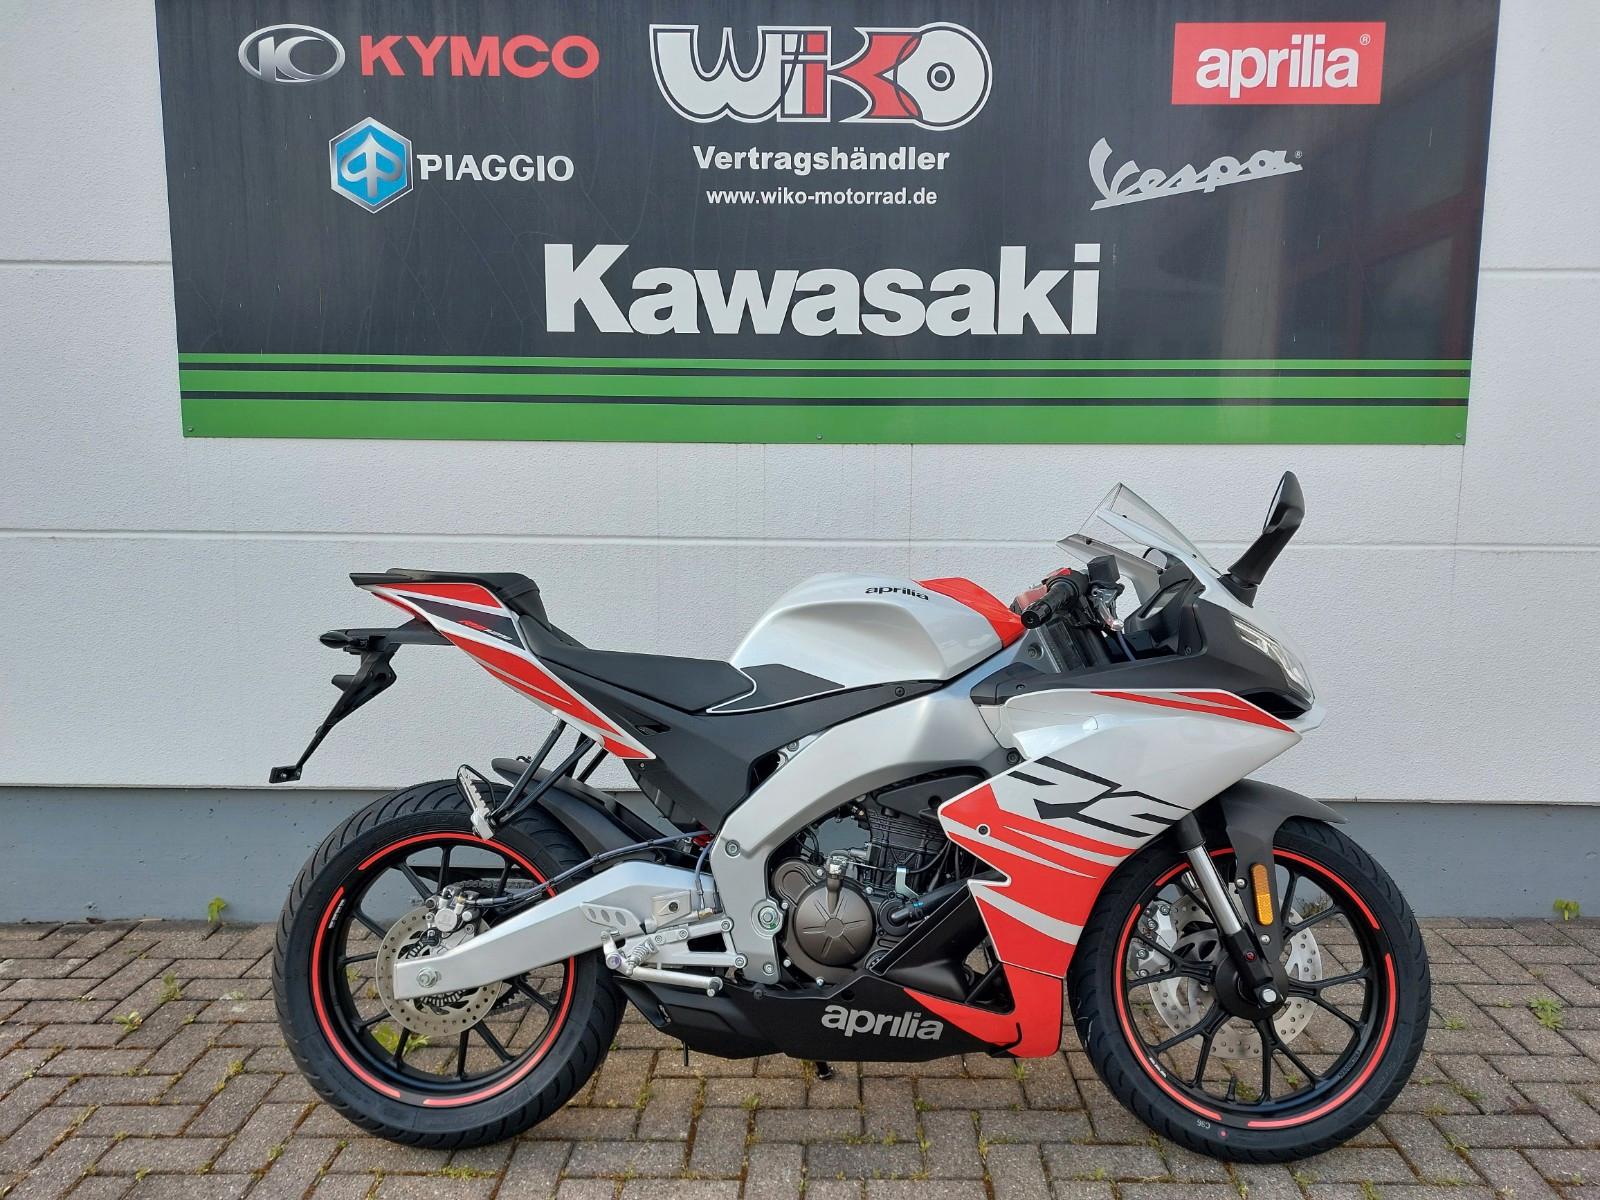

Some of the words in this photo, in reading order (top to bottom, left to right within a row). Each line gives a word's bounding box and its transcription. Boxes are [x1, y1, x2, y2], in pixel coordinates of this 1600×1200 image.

[359, 35, 599, 78] KYMCO
[1196, 34, 1359, 98] aprilia
[416, 154, 575, 182] PIAGGIO
[693, 146, 950, 175] Vertragshändler
[1089, 137, 1303, 210] Vespa
[706, 187, 937, 205] www.wiko-motorrad.de
[544, 243, 1101, 336] Kawasaki
[865, 586, 929, 601] aprilia
[821, 1004, 944, 1040] aprilia
